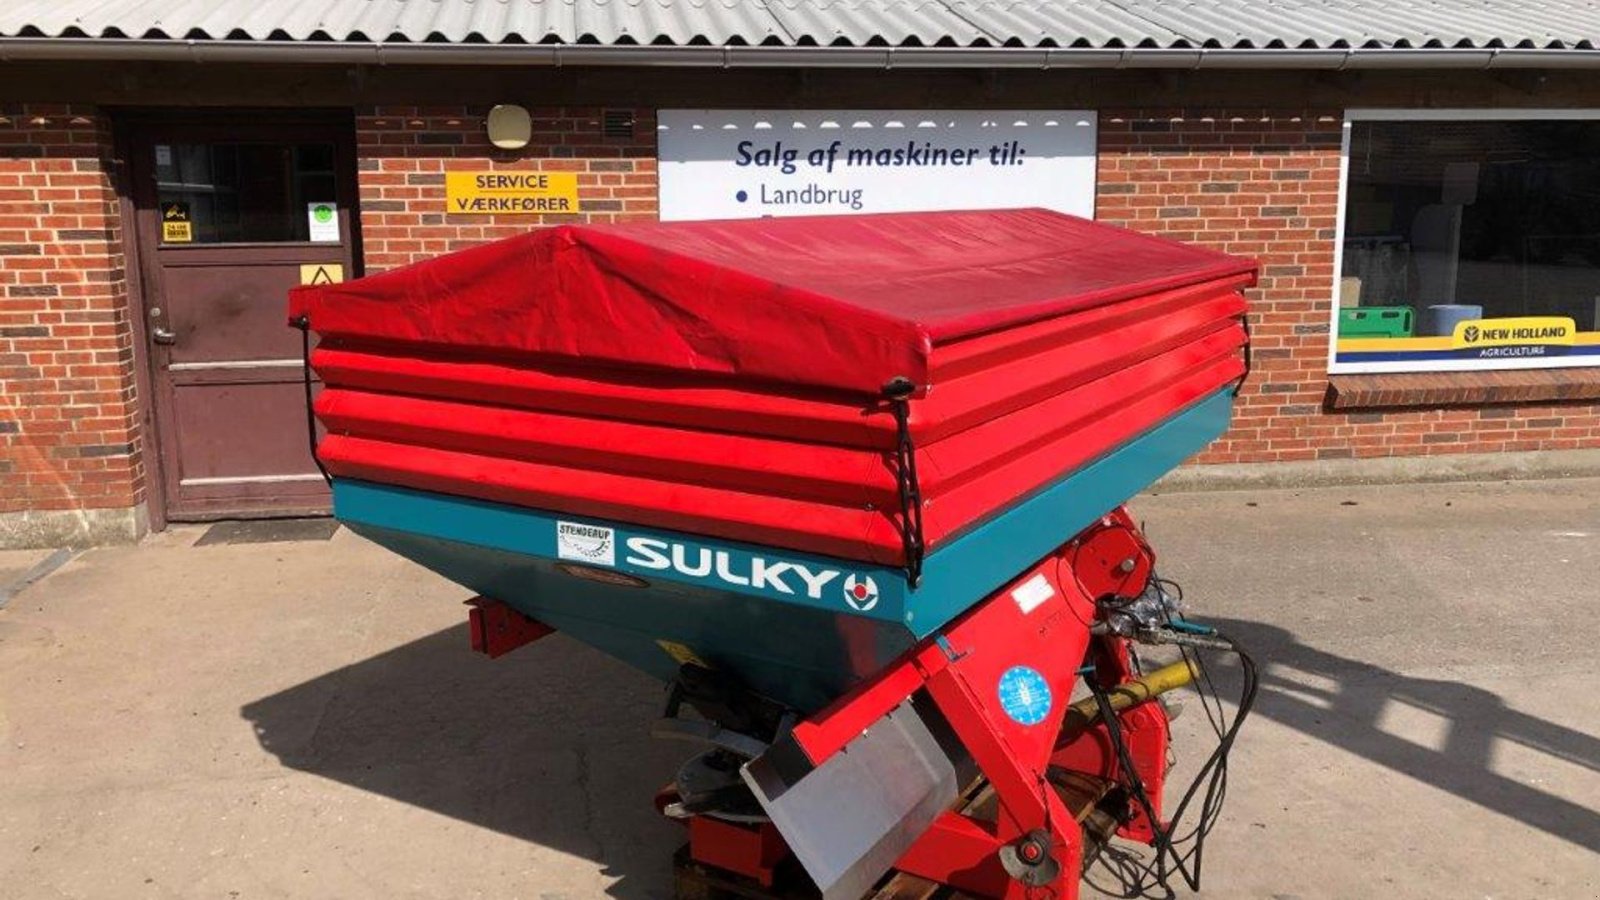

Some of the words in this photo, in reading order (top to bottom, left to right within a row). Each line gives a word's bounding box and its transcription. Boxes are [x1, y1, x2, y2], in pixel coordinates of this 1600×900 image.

[736, 140, 798, 174] Salg
[808, 140, 841, 173] af
[847, 140, 979, 166] maskiner
[989, 140, 1026, 166] til:
[476, 175, 549, 189] SERVICE
[761, 183, 863, 210] Landbrug
[456, 198, 570, 211] VÆRKFØRER
[1482, 329, 1510, 340] NEW
[1512, 327, 1566, 339] HOLLAND
[1480, 346, 1545, 357] AGRICULTURE
[560, 524, 610, 540] STENDERUP
[626, 537, 840, 599] SULKY
